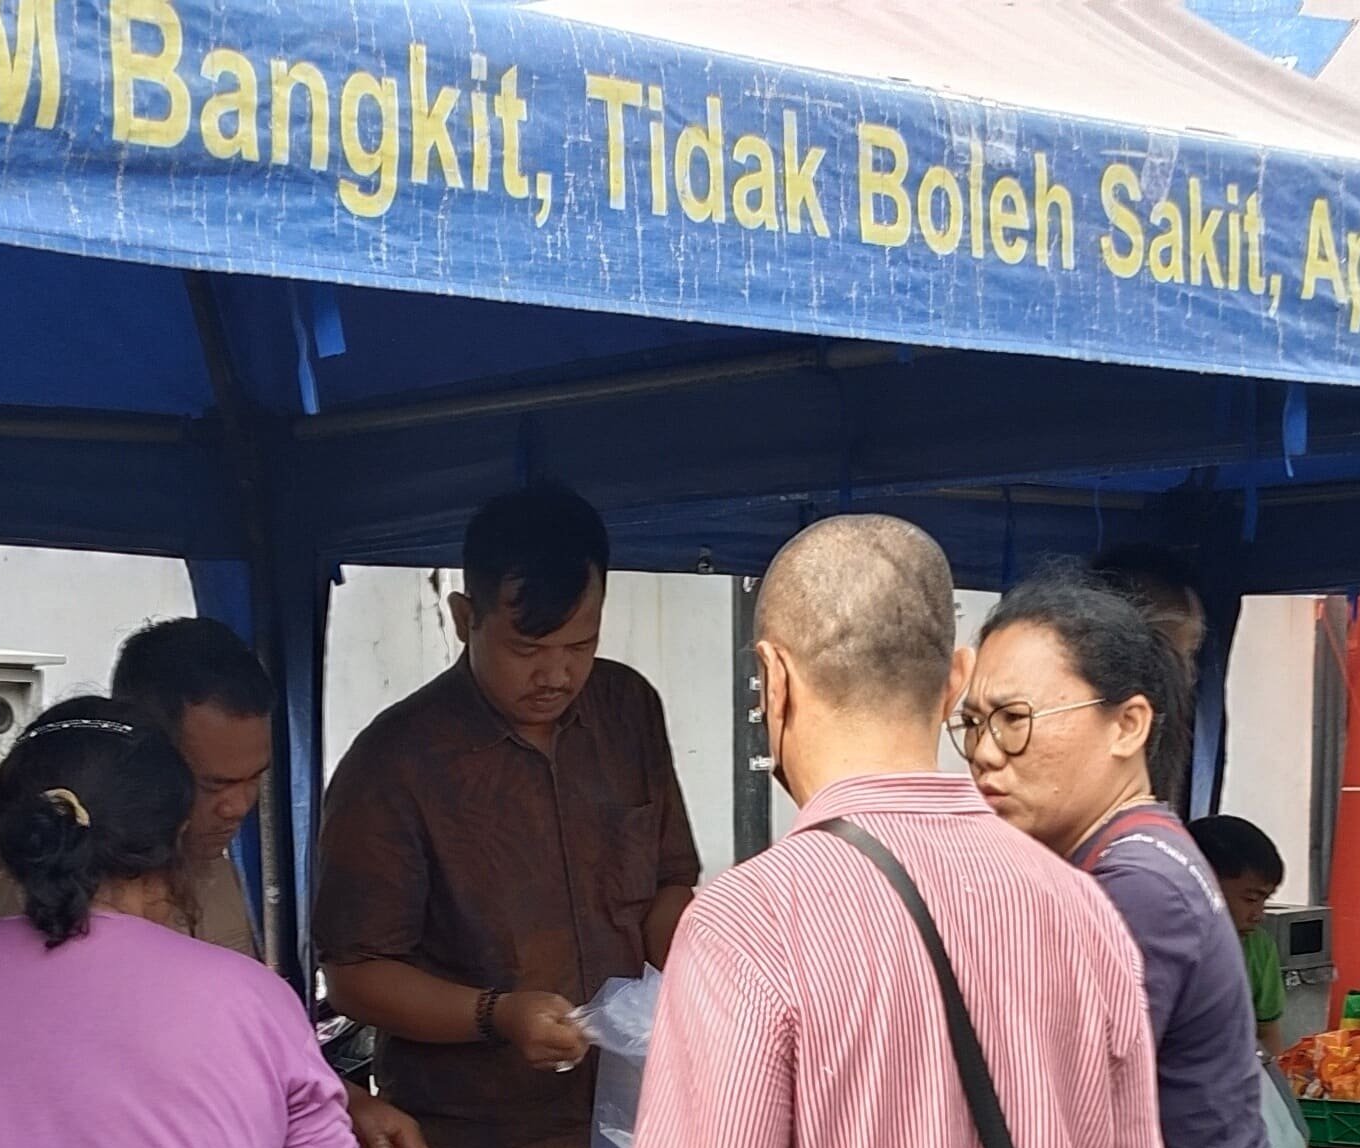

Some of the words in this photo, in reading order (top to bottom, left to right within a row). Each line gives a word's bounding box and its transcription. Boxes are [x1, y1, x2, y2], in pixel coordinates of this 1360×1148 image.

[110, 0, 552, 228] Bangkit,
[585, 73, 830, 238] Tidak
[857, 121, 1076, 271] Boleh
[1099, 163, 1283, 319] Sakit,
